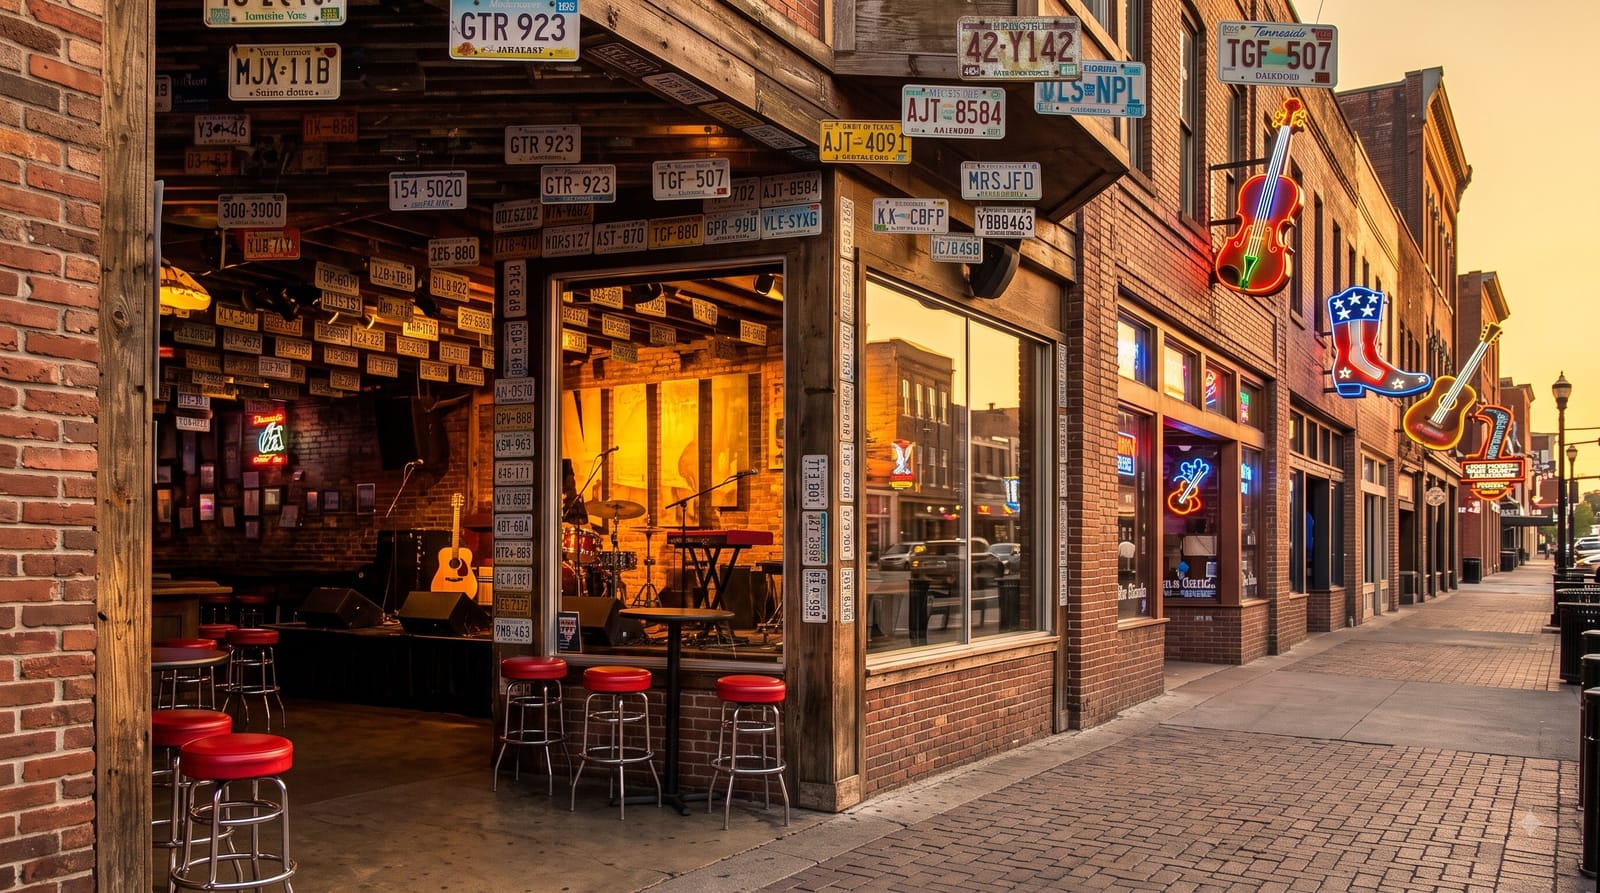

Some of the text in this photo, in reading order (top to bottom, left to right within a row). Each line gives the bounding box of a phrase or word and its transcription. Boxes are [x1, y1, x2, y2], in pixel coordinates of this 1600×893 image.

[461, 12, 566, 42] GTR 923
[1227, 39, 1331, 70] TGF 507
[1096, 76, 1140, 105] NPL
[907, 98, 1001, 125] AJT 8584
[510, 135, 574, 154] GTR 923
[823, 131, 908, 154] AJT-4091
[763, 179, 818, 199] AJT-8584
[222, 202, 282, 219] 300-3900
[596, 227, 644, 247] AST-870
